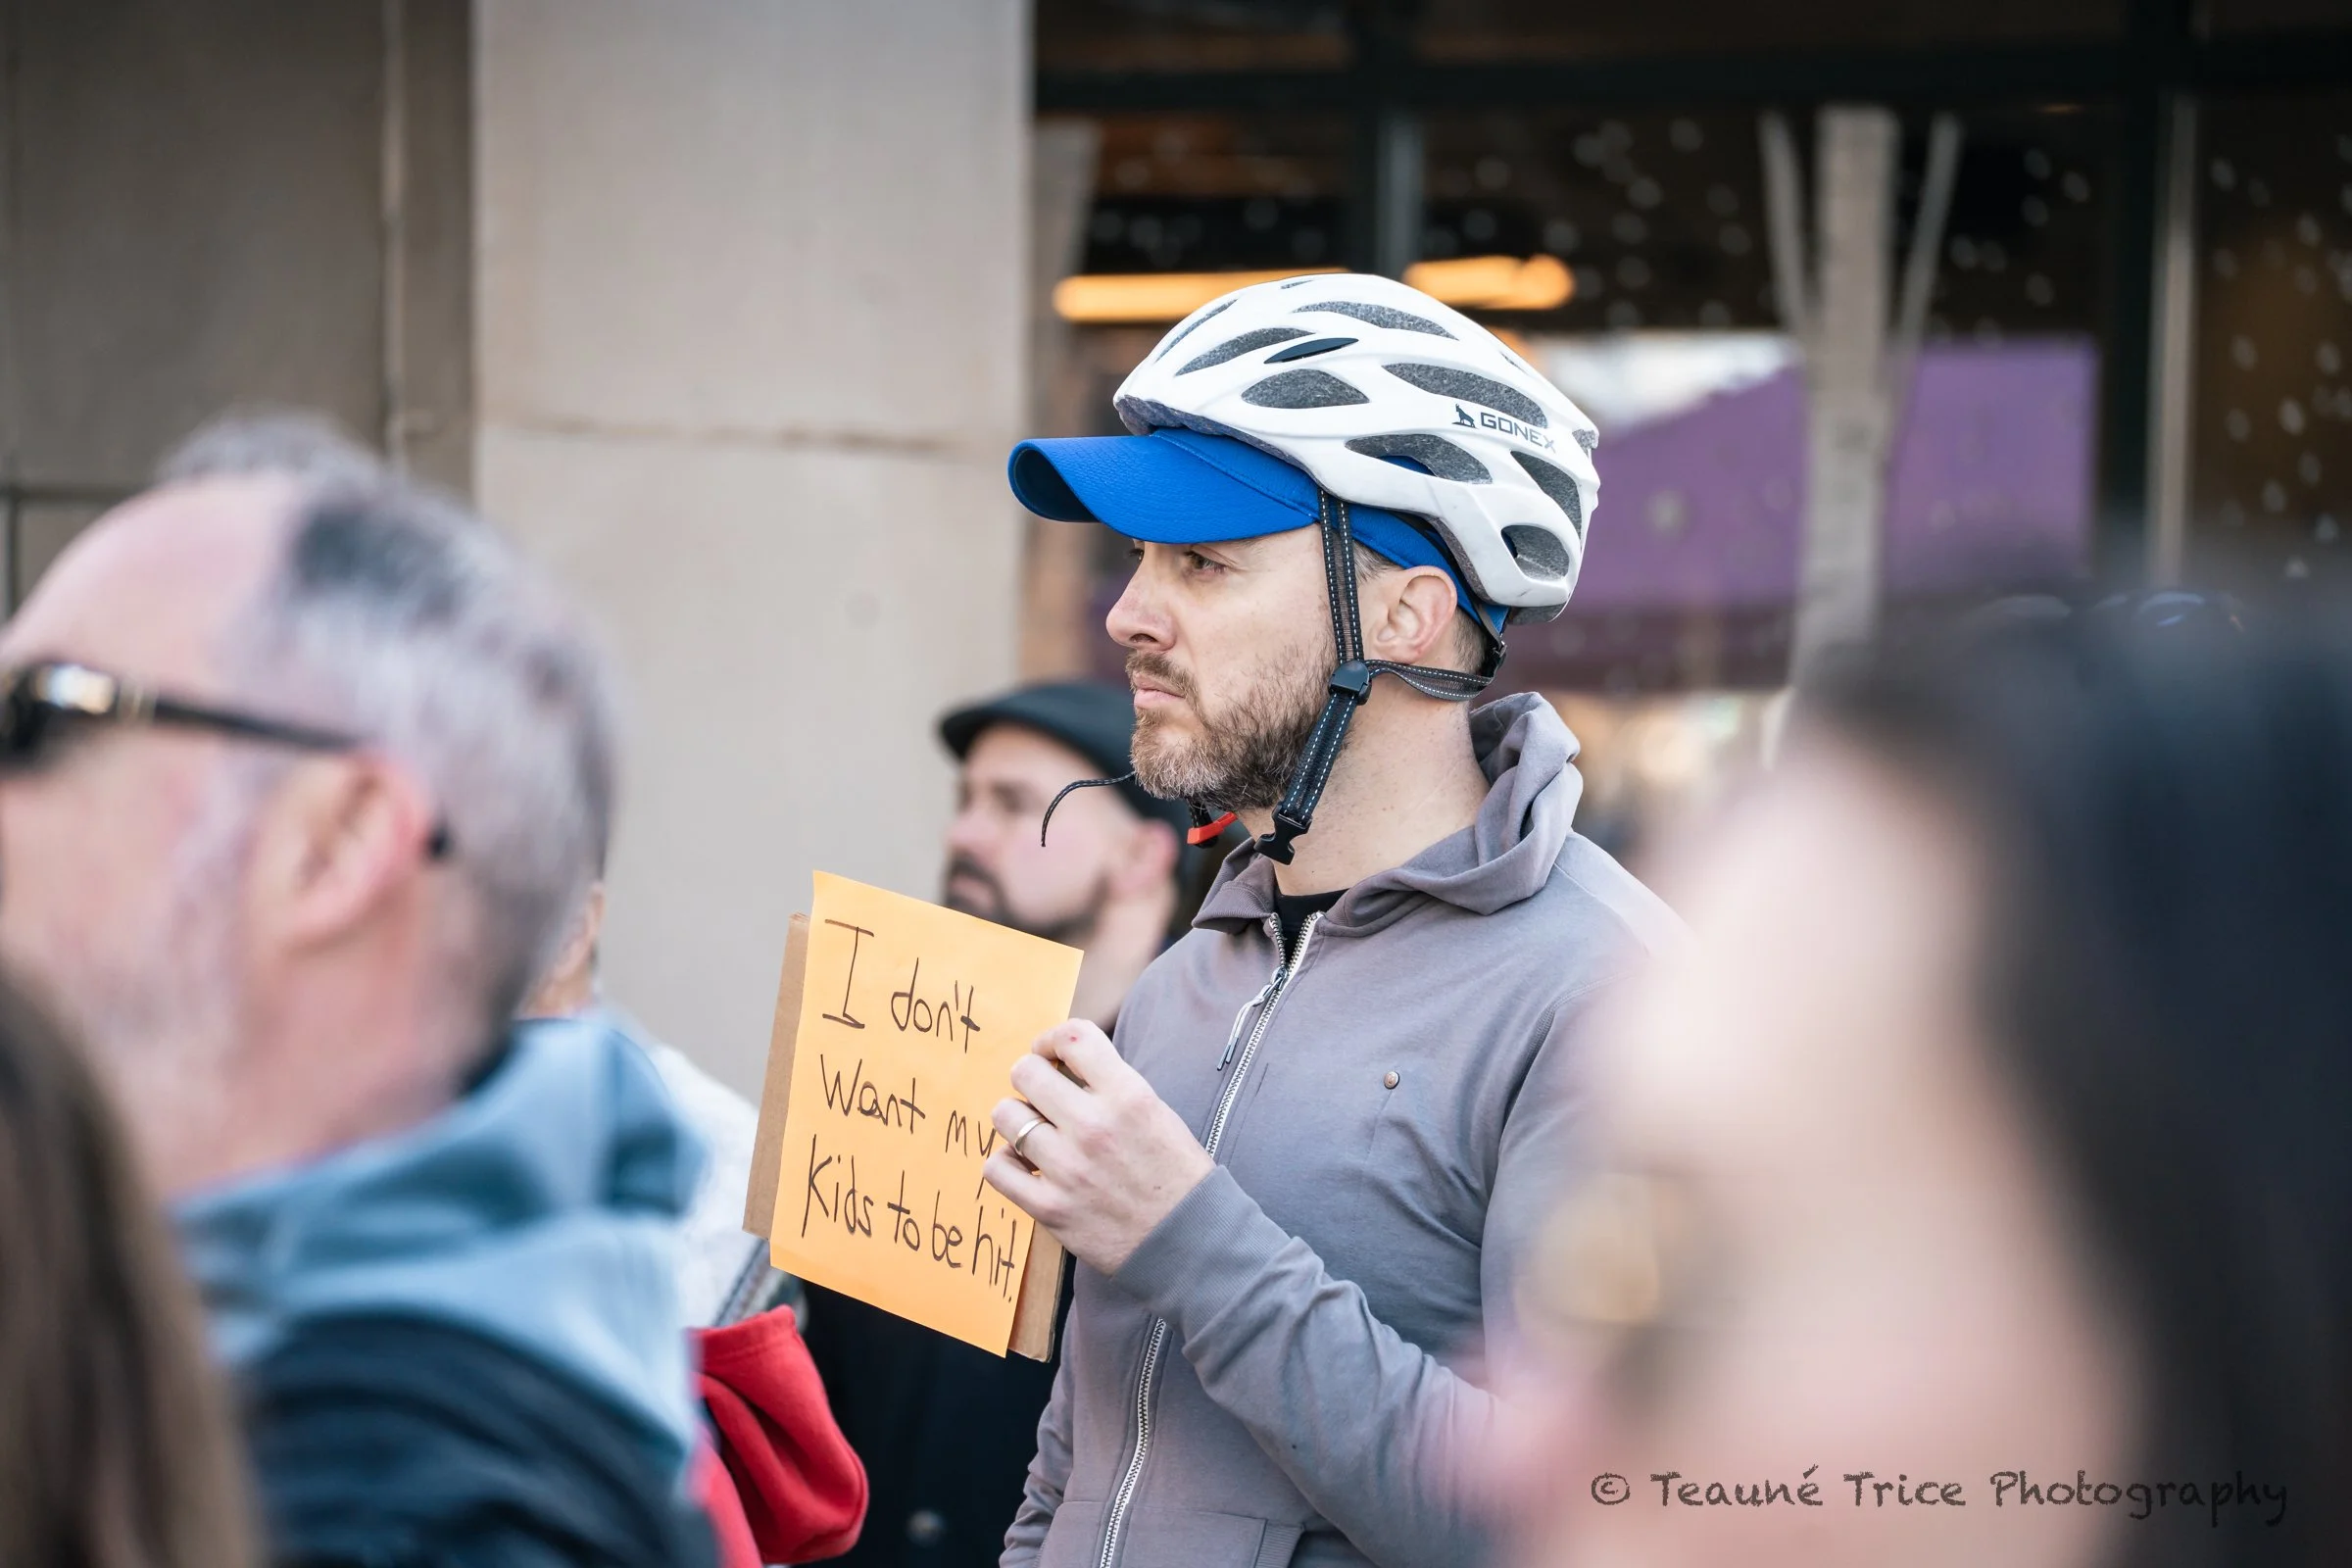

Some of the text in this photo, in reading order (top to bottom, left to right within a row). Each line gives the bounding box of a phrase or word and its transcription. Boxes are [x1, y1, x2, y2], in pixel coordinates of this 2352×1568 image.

[1480, 412, 1556, 454] GONEX
[821, 918, 981, 1054] I don't
[945, 1109, 997, 1200] my
[887, 1170, 920, 1251] to
[931, 1189, 963, 1269] be
